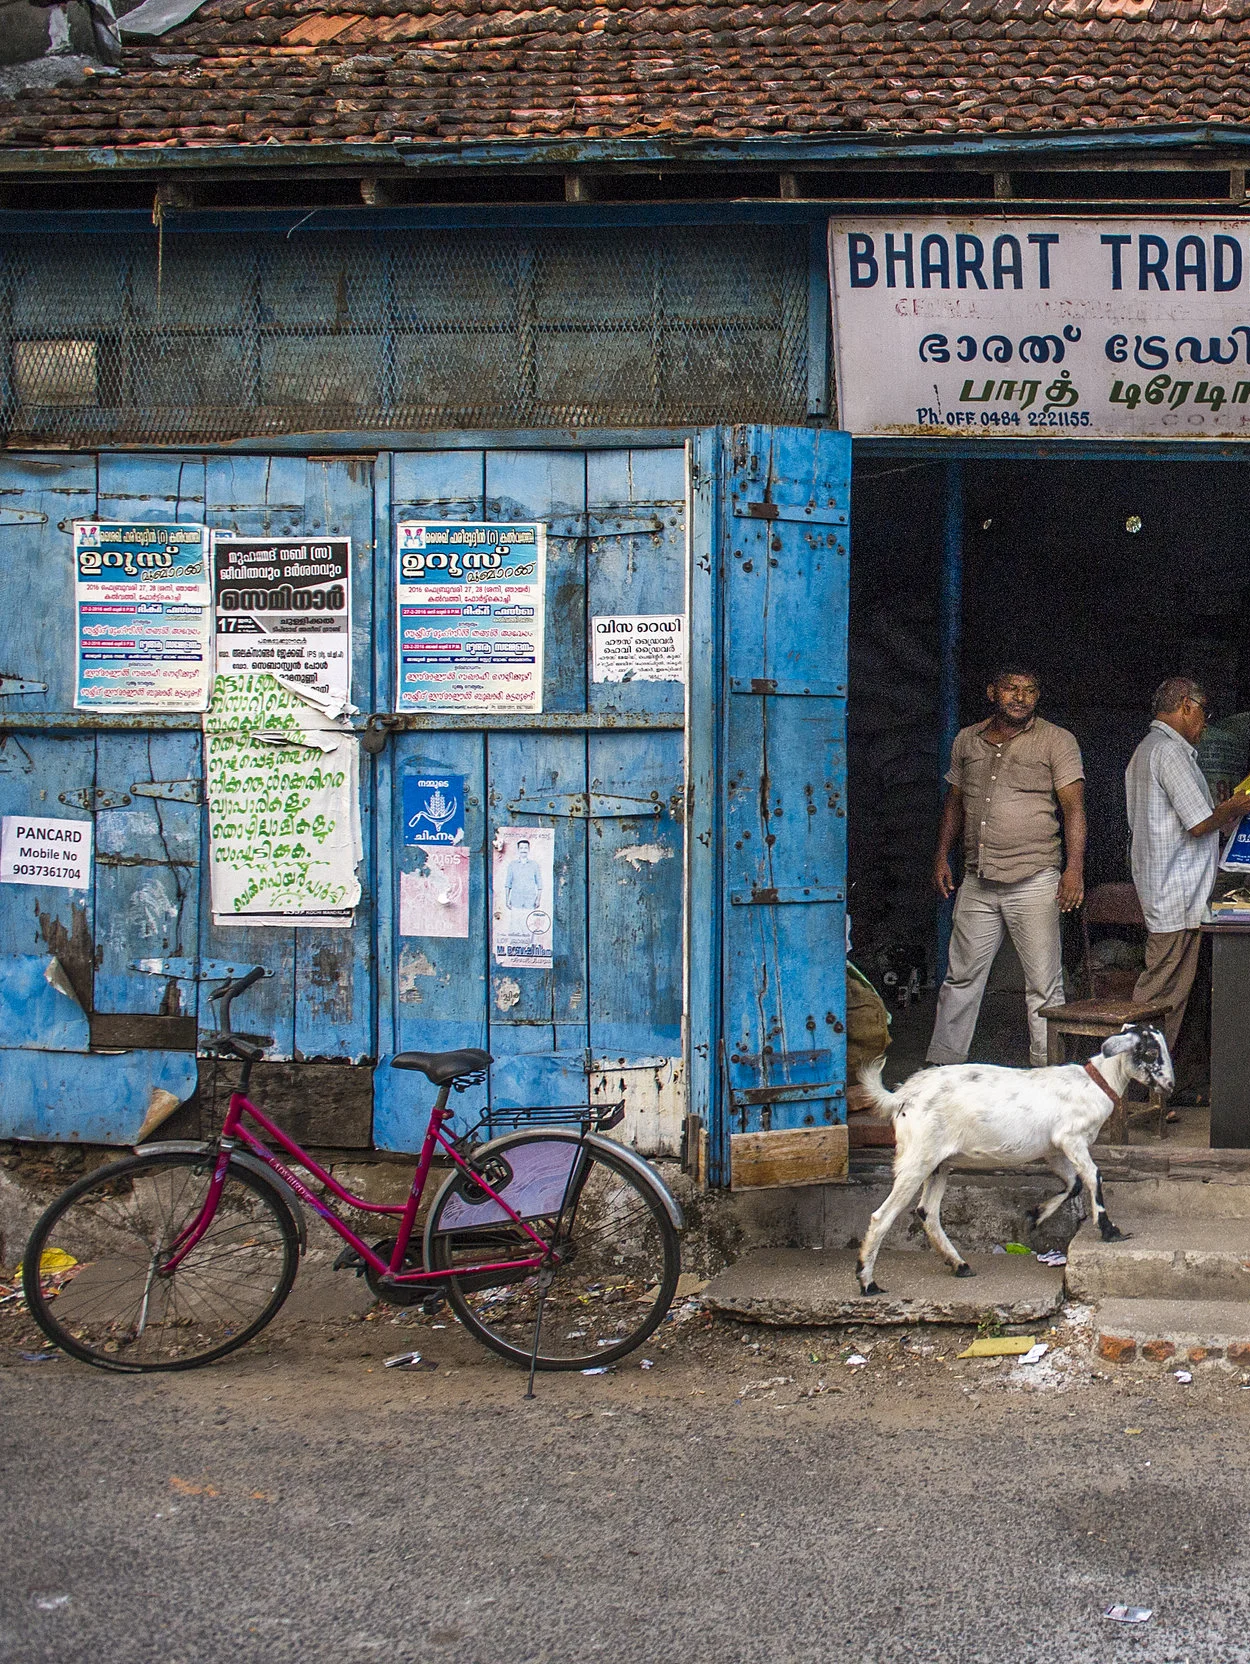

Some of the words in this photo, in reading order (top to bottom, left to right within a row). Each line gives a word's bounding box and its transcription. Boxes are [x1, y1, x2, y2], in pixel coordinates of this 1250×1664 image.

[847, 232, 1060, 290] BHARAT
[918, 324, 1082, 364] ഭാരത്
[958, 370, 1080, 412] பாரத்
[280, 545, 307, 561] നബി
[401, 545, 510, 578] ഉറൂസ്
[220, 583, 345, 611] സെമിനാർ
[218, 618, 237, 632] 17
[596, 619, 633, 634] വിസ
[637, 618, 681, 633] റെഡി
[307, 650, 317, 658] IPS
[417, 779, 449, 790] നമ്മുടെ
[16, 826, 82, 843] PANCARD
[19, 847, 60, 861] Mobile
[63, 850, 78, 862] No
[12, 863, 81, 880] 9037361704
